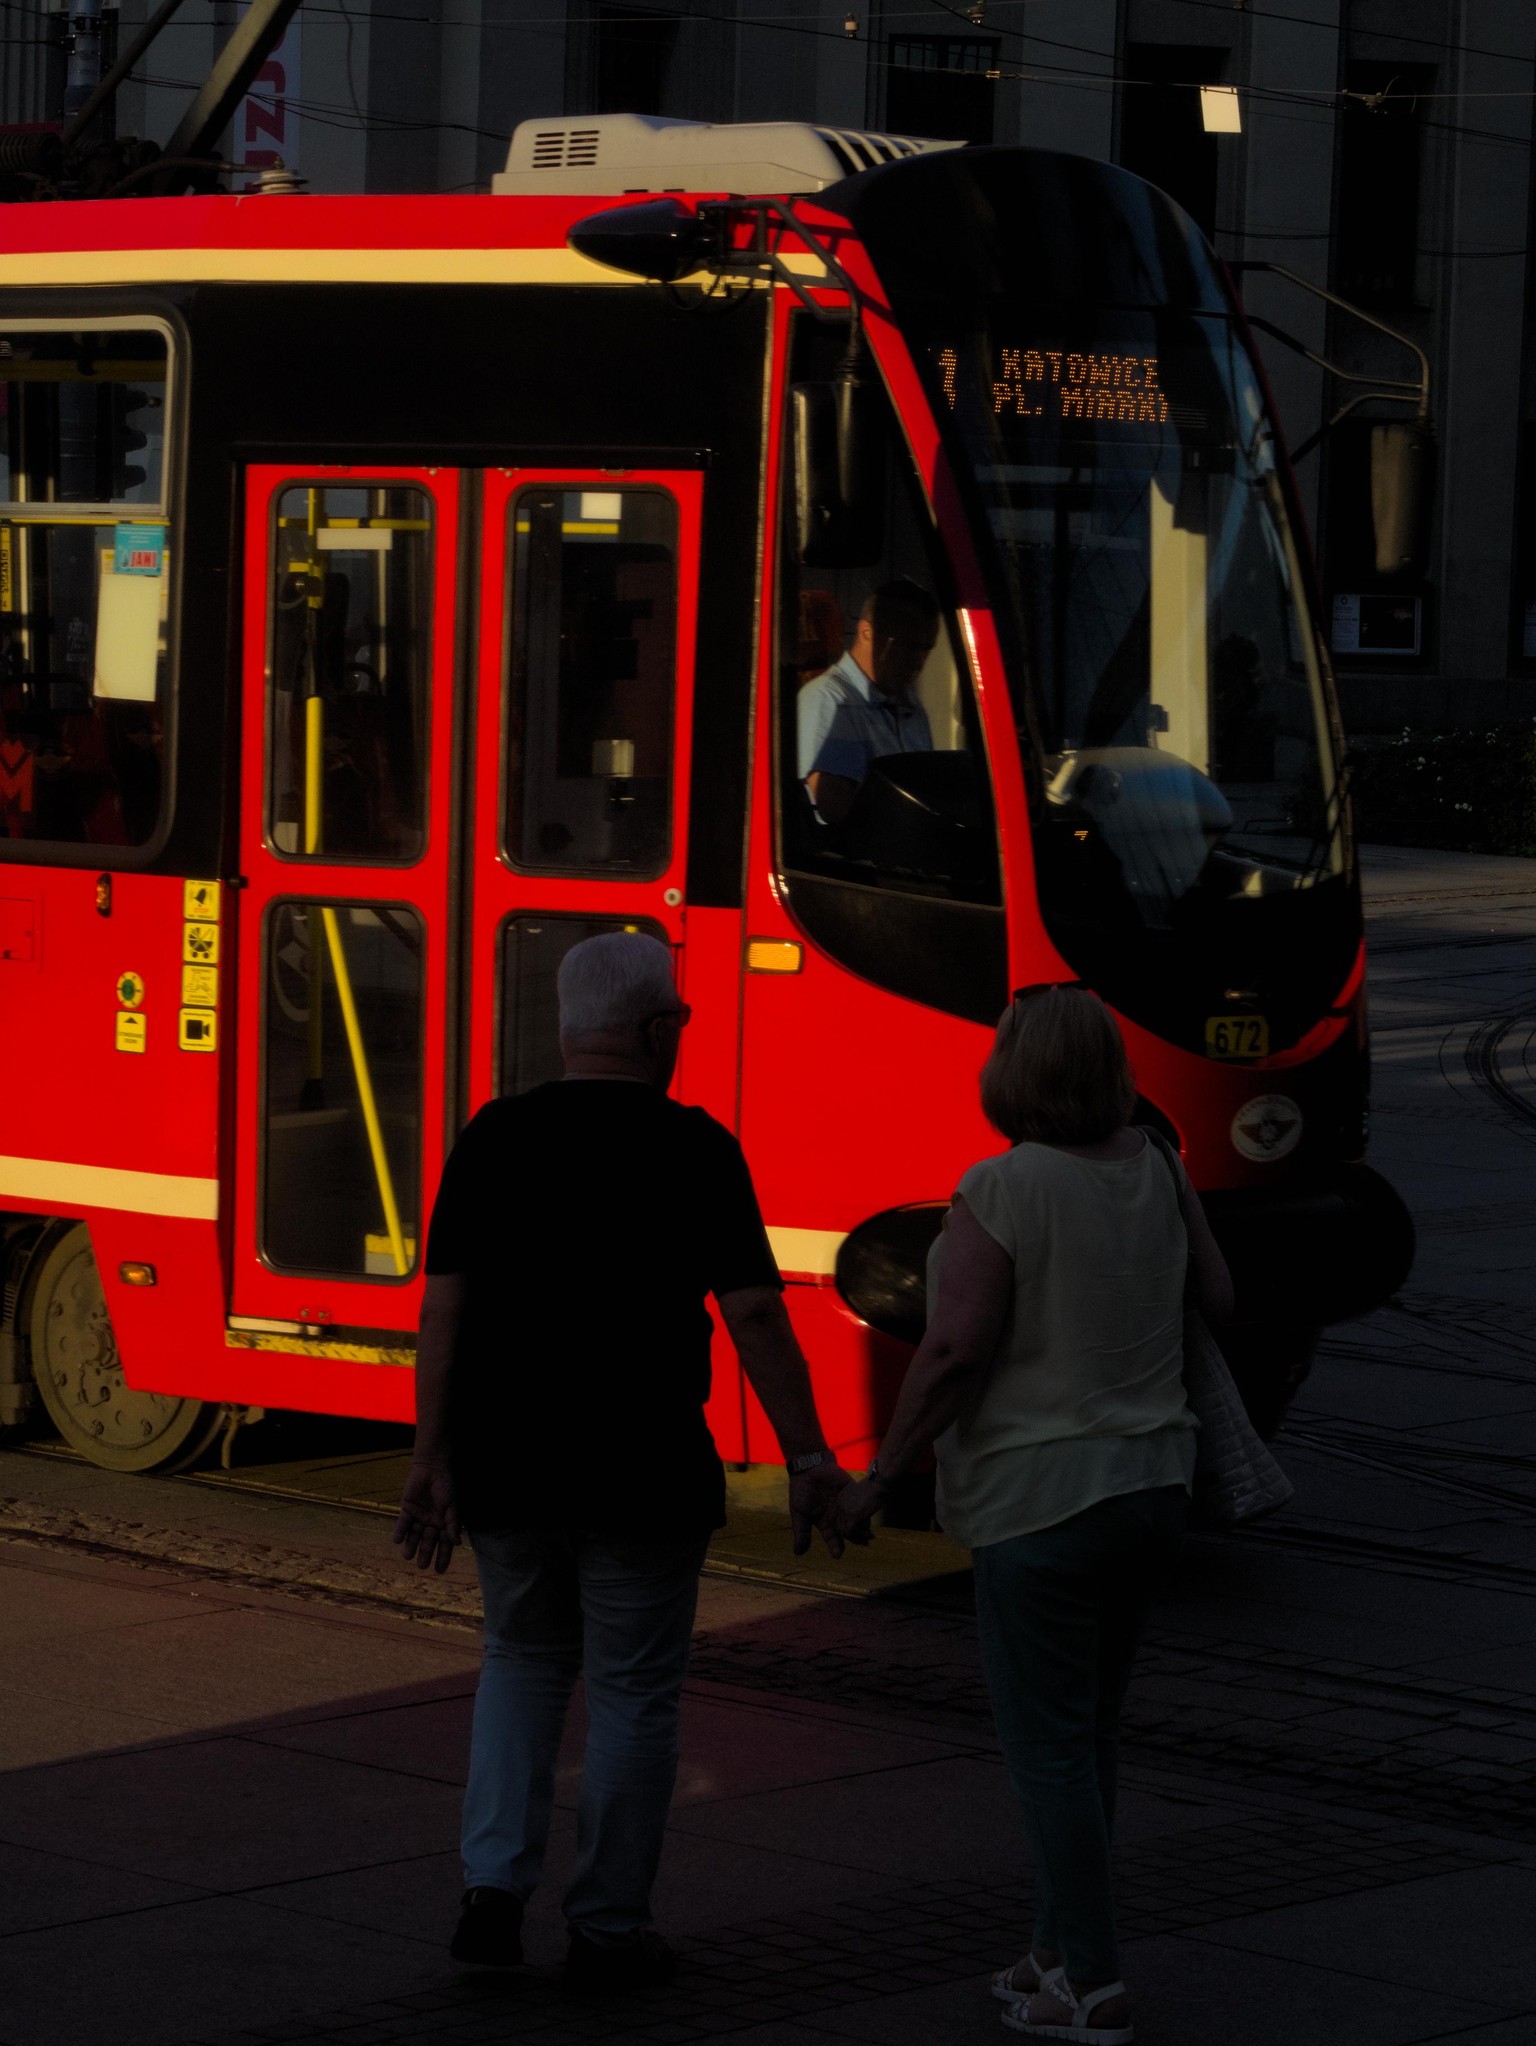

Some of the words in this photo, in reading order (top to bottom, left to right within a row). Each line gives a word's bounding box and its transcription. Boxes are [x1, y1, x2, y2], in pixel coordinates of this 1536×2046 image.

[937, 348, 957, 411] 1
[1001, 348, 1160, 389] KATOWICE
[992, 382, 1044, 415] PL.
[1215, 1021, 1261, 1055] 672
